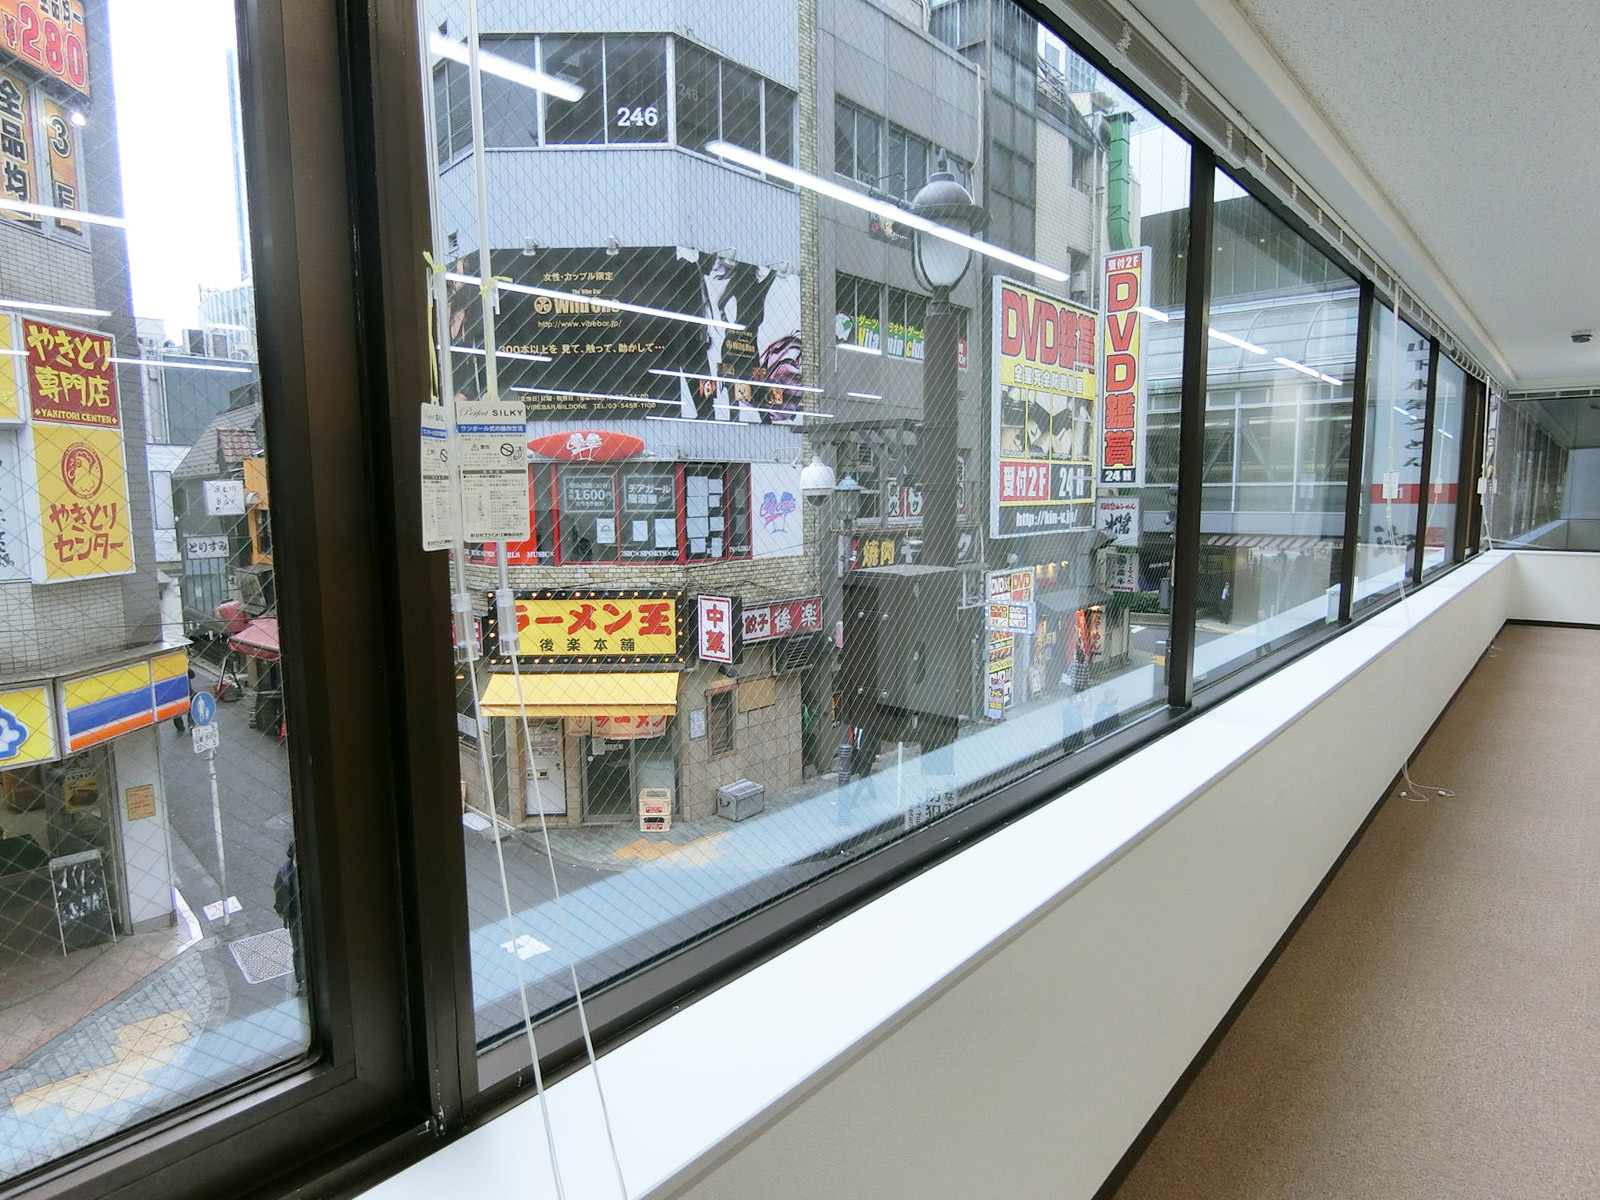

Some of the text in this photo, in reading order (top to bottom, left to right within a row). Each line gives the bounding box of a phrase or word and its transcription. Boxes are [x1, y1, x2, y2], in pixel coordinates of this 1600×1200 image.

[3, 3, 85, 88] ¥280
[617, 106, 659, 127] 246
[1108, 255, 1139, 271] 受付2F
[1001, 286, 1096, 375] DVD鑑賞
[27, 324, 112, 372] やきとり
[1104, 272, 1138, 468] DVD鑑賞
[35, 365, 111, 408] 専門店
[41, 408, 113, 424] YAKITORI CENTER
[492, 409, 524, 417] SILKY
[628, 483, 672, 494] チアガール
[1003, 465, 1047, 497] 受付2F
[1058, 467, 1085, 497] 24H
[1105, 470, 1133, 482] 24H
[49, 502, 118, 533] やきとり
[53, 532, 124, 563] センター
[188, 541, 228, 553] とりすみ
[705, 603, 726, 654] 中華
[773, 602, 818, 633] 後楽
[539, 637, 636, 652] 後楽本舗
